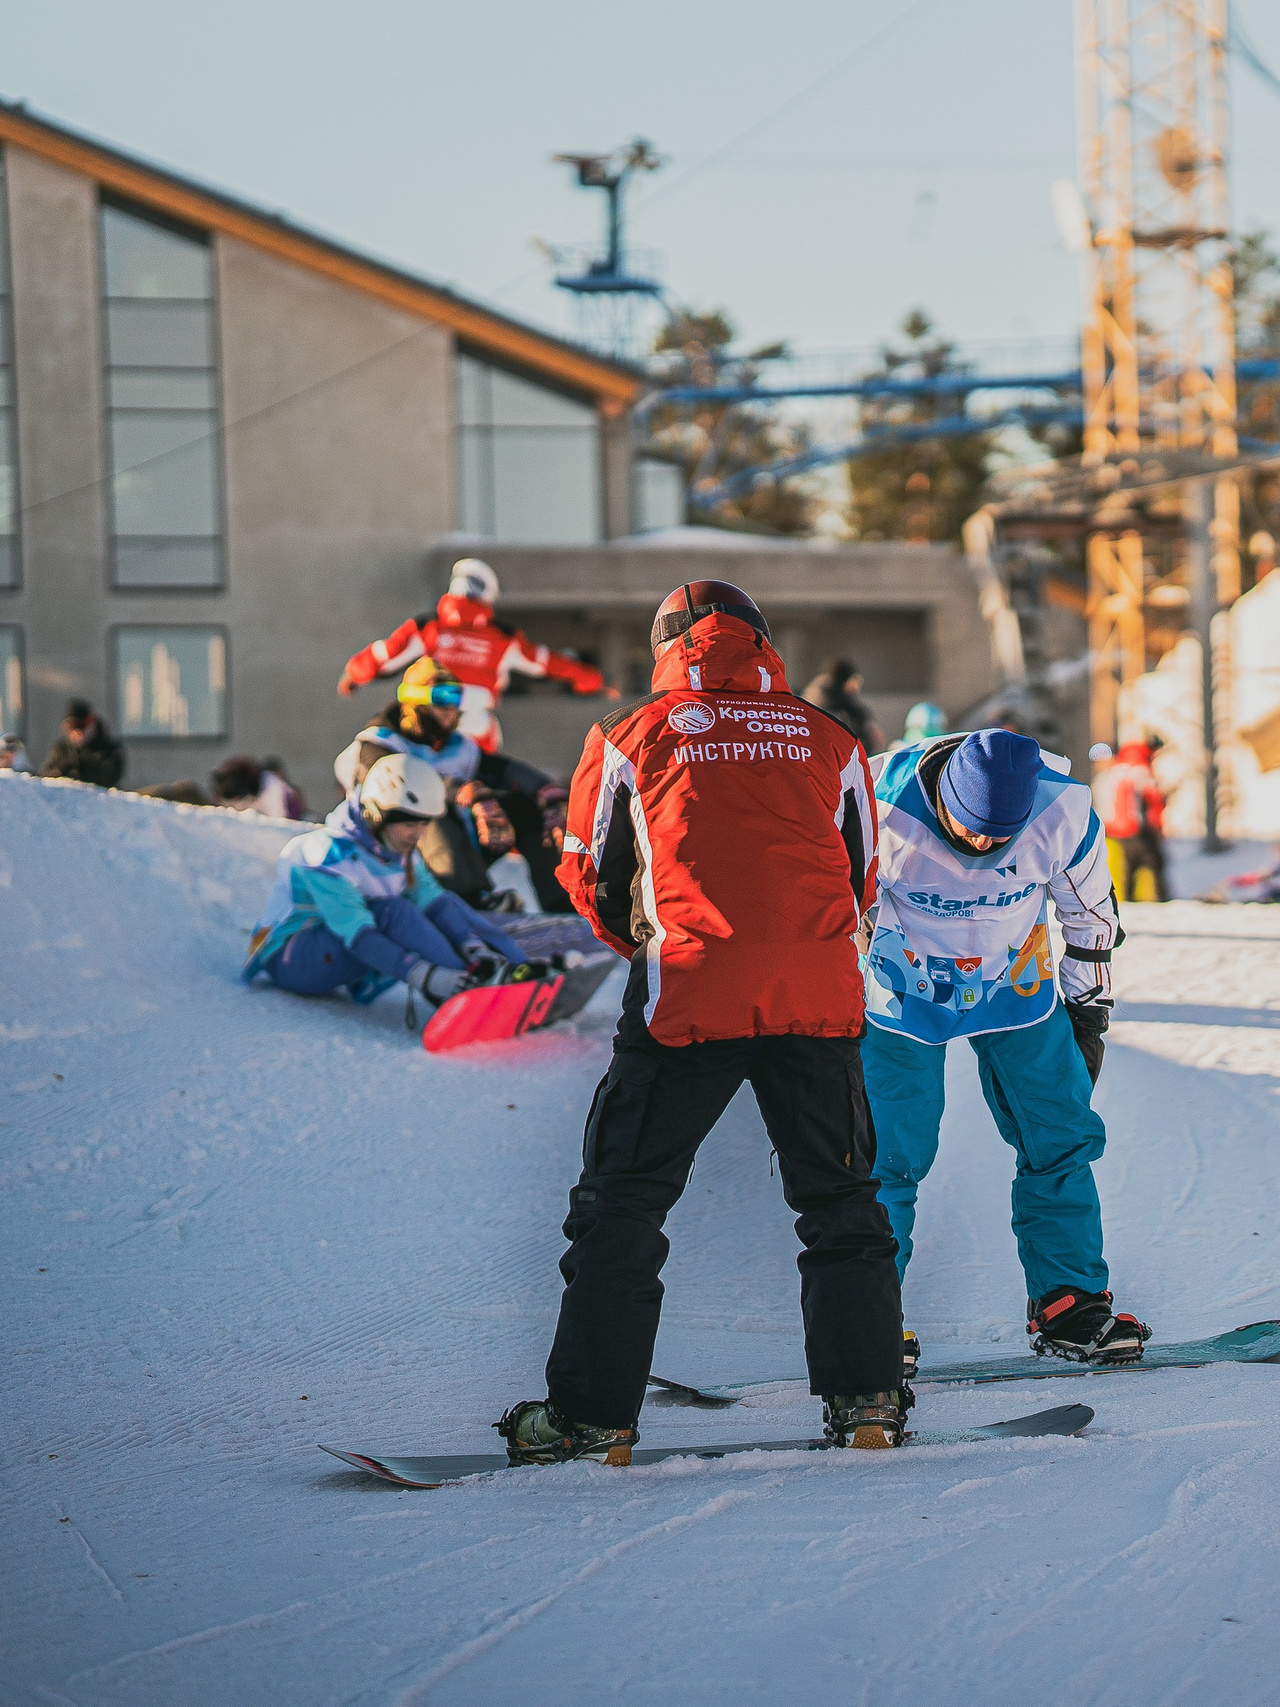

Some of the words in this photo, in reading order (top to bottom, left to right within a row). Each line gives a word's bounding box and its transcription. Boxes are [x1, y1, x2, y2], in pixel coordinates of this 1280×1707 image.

[718, 707, 808, 723] Красное
[746, 720, 811, 738] Озеро
[673, 741, 812, 765] ИНСТРУКТОР
[907, 883, 1038, 911] StarLine
